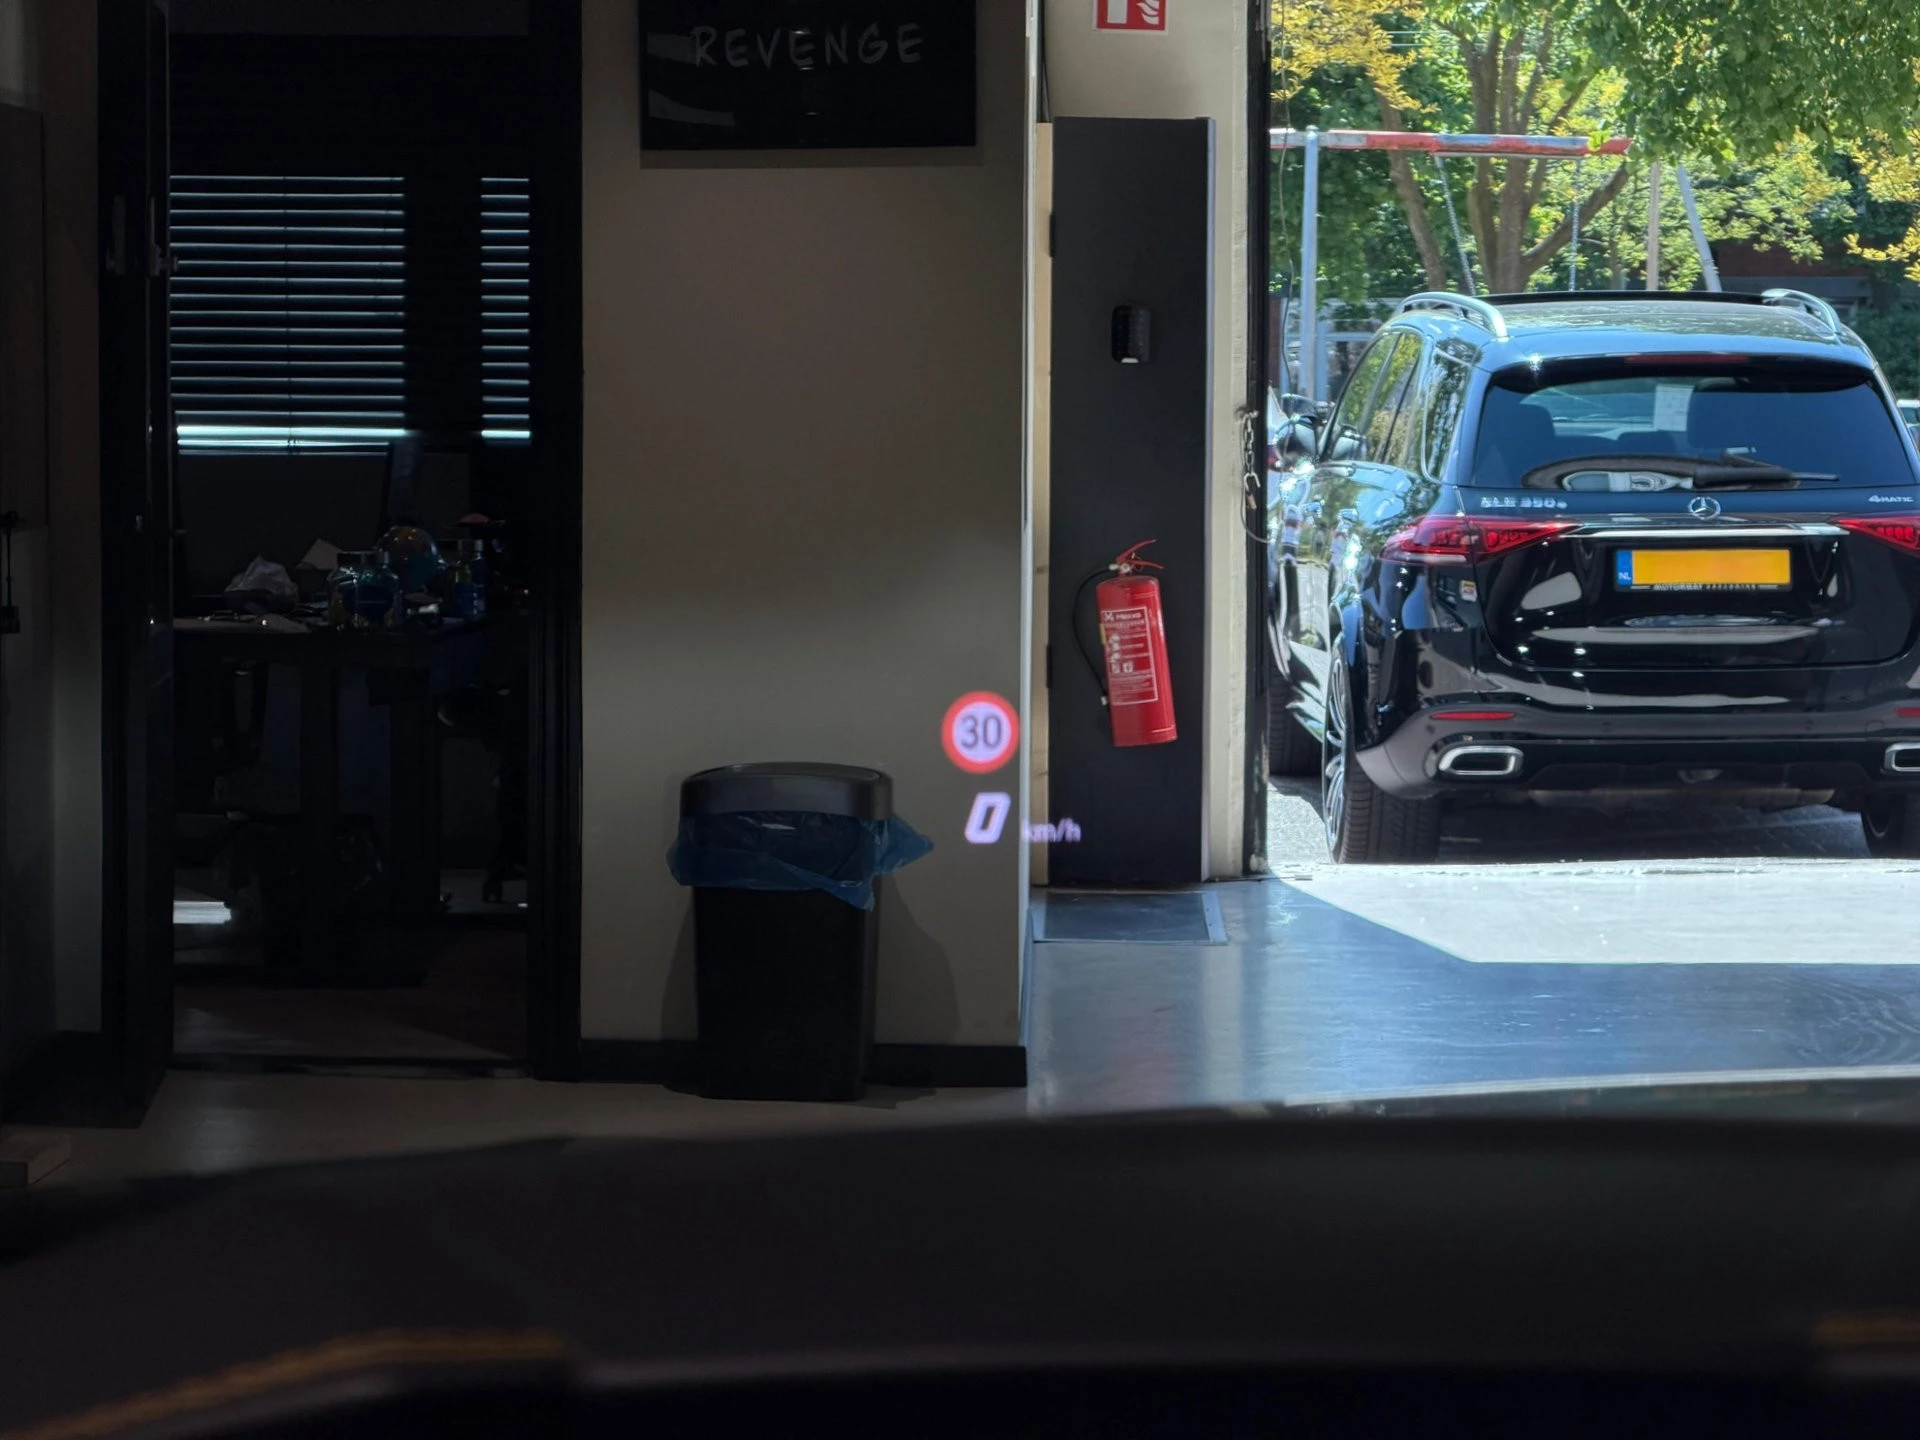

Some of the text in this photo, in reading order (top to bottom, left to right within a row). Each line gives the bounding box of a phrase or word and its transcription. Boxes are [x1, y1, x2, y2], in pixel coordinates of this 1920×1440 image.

[691, 22, 923, 69] REVENGE
[1618, 571, 1631, 580] NL
[960, 714, 1002, 749] 30
[964, 791, 1082, 844] 0 km/h
